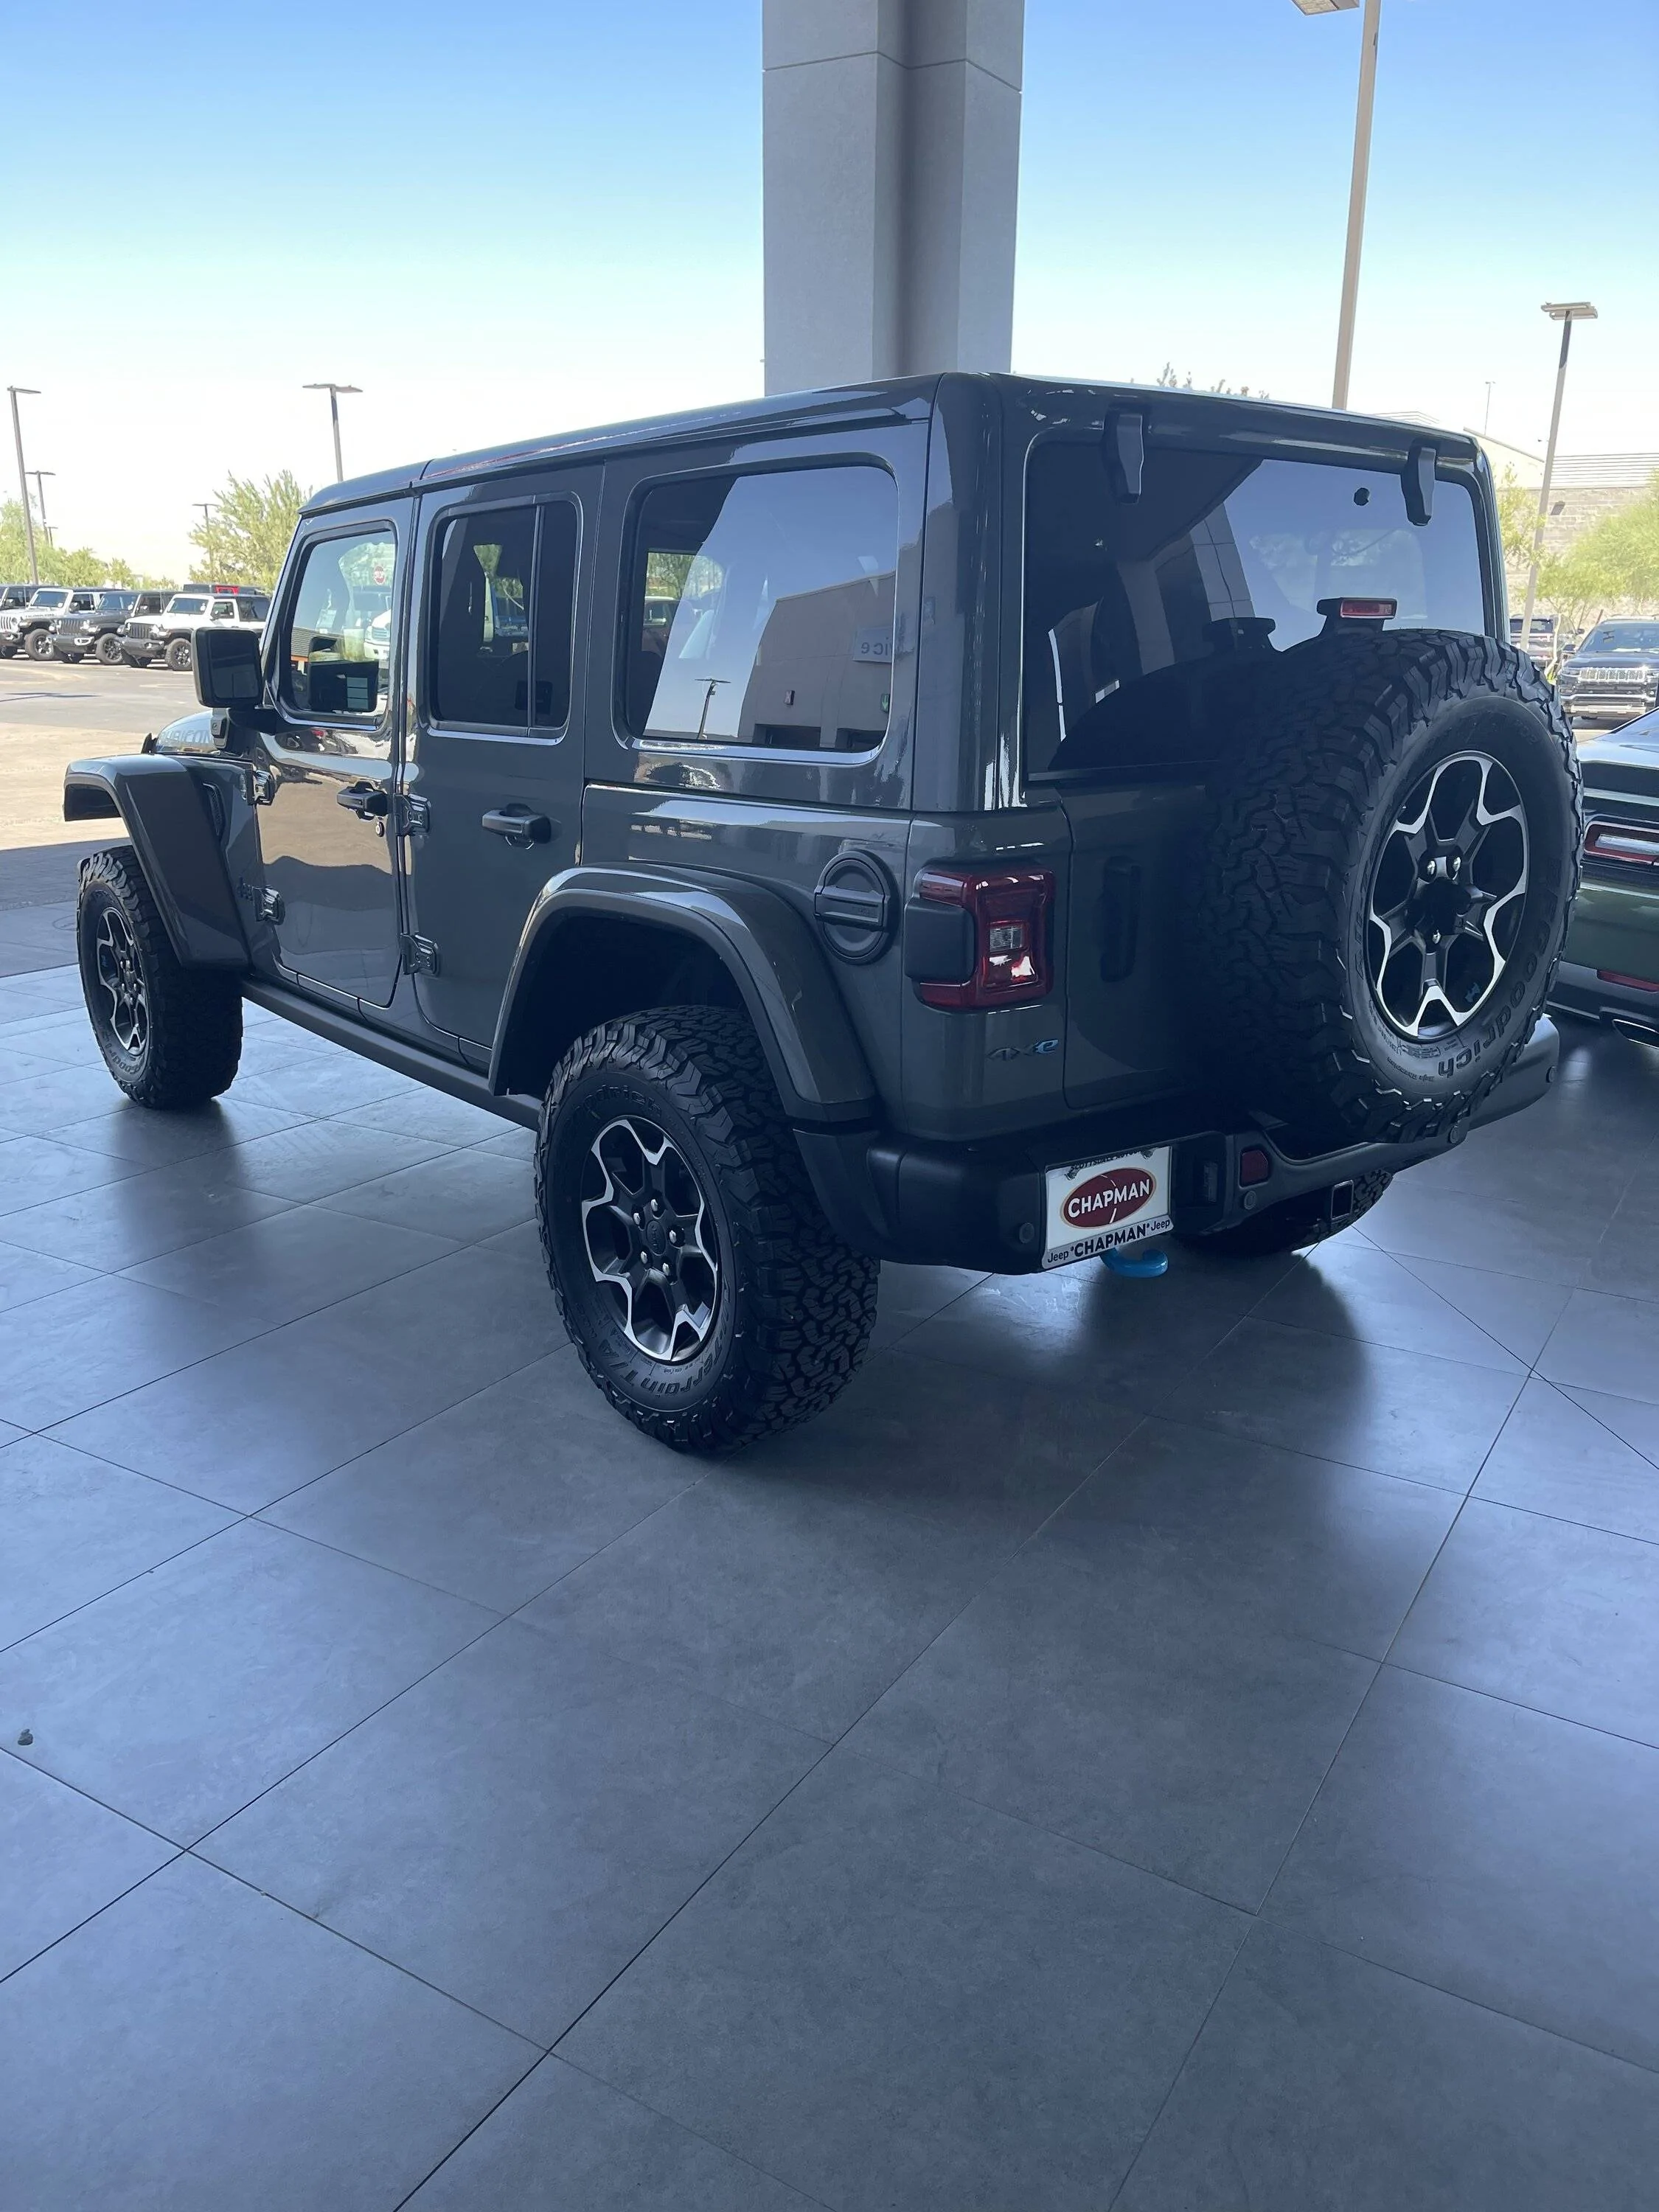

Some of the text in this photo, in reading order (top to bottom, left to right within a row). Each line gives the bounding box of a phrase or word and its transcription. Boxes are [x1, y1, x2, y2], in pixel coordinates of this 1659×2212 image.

[1068, 1179, 1150, 1218] CHAPMAN
[1047, 1250, 1069, 1263] Jeep
[1151, 1220, 1170, 1231] Jeep
